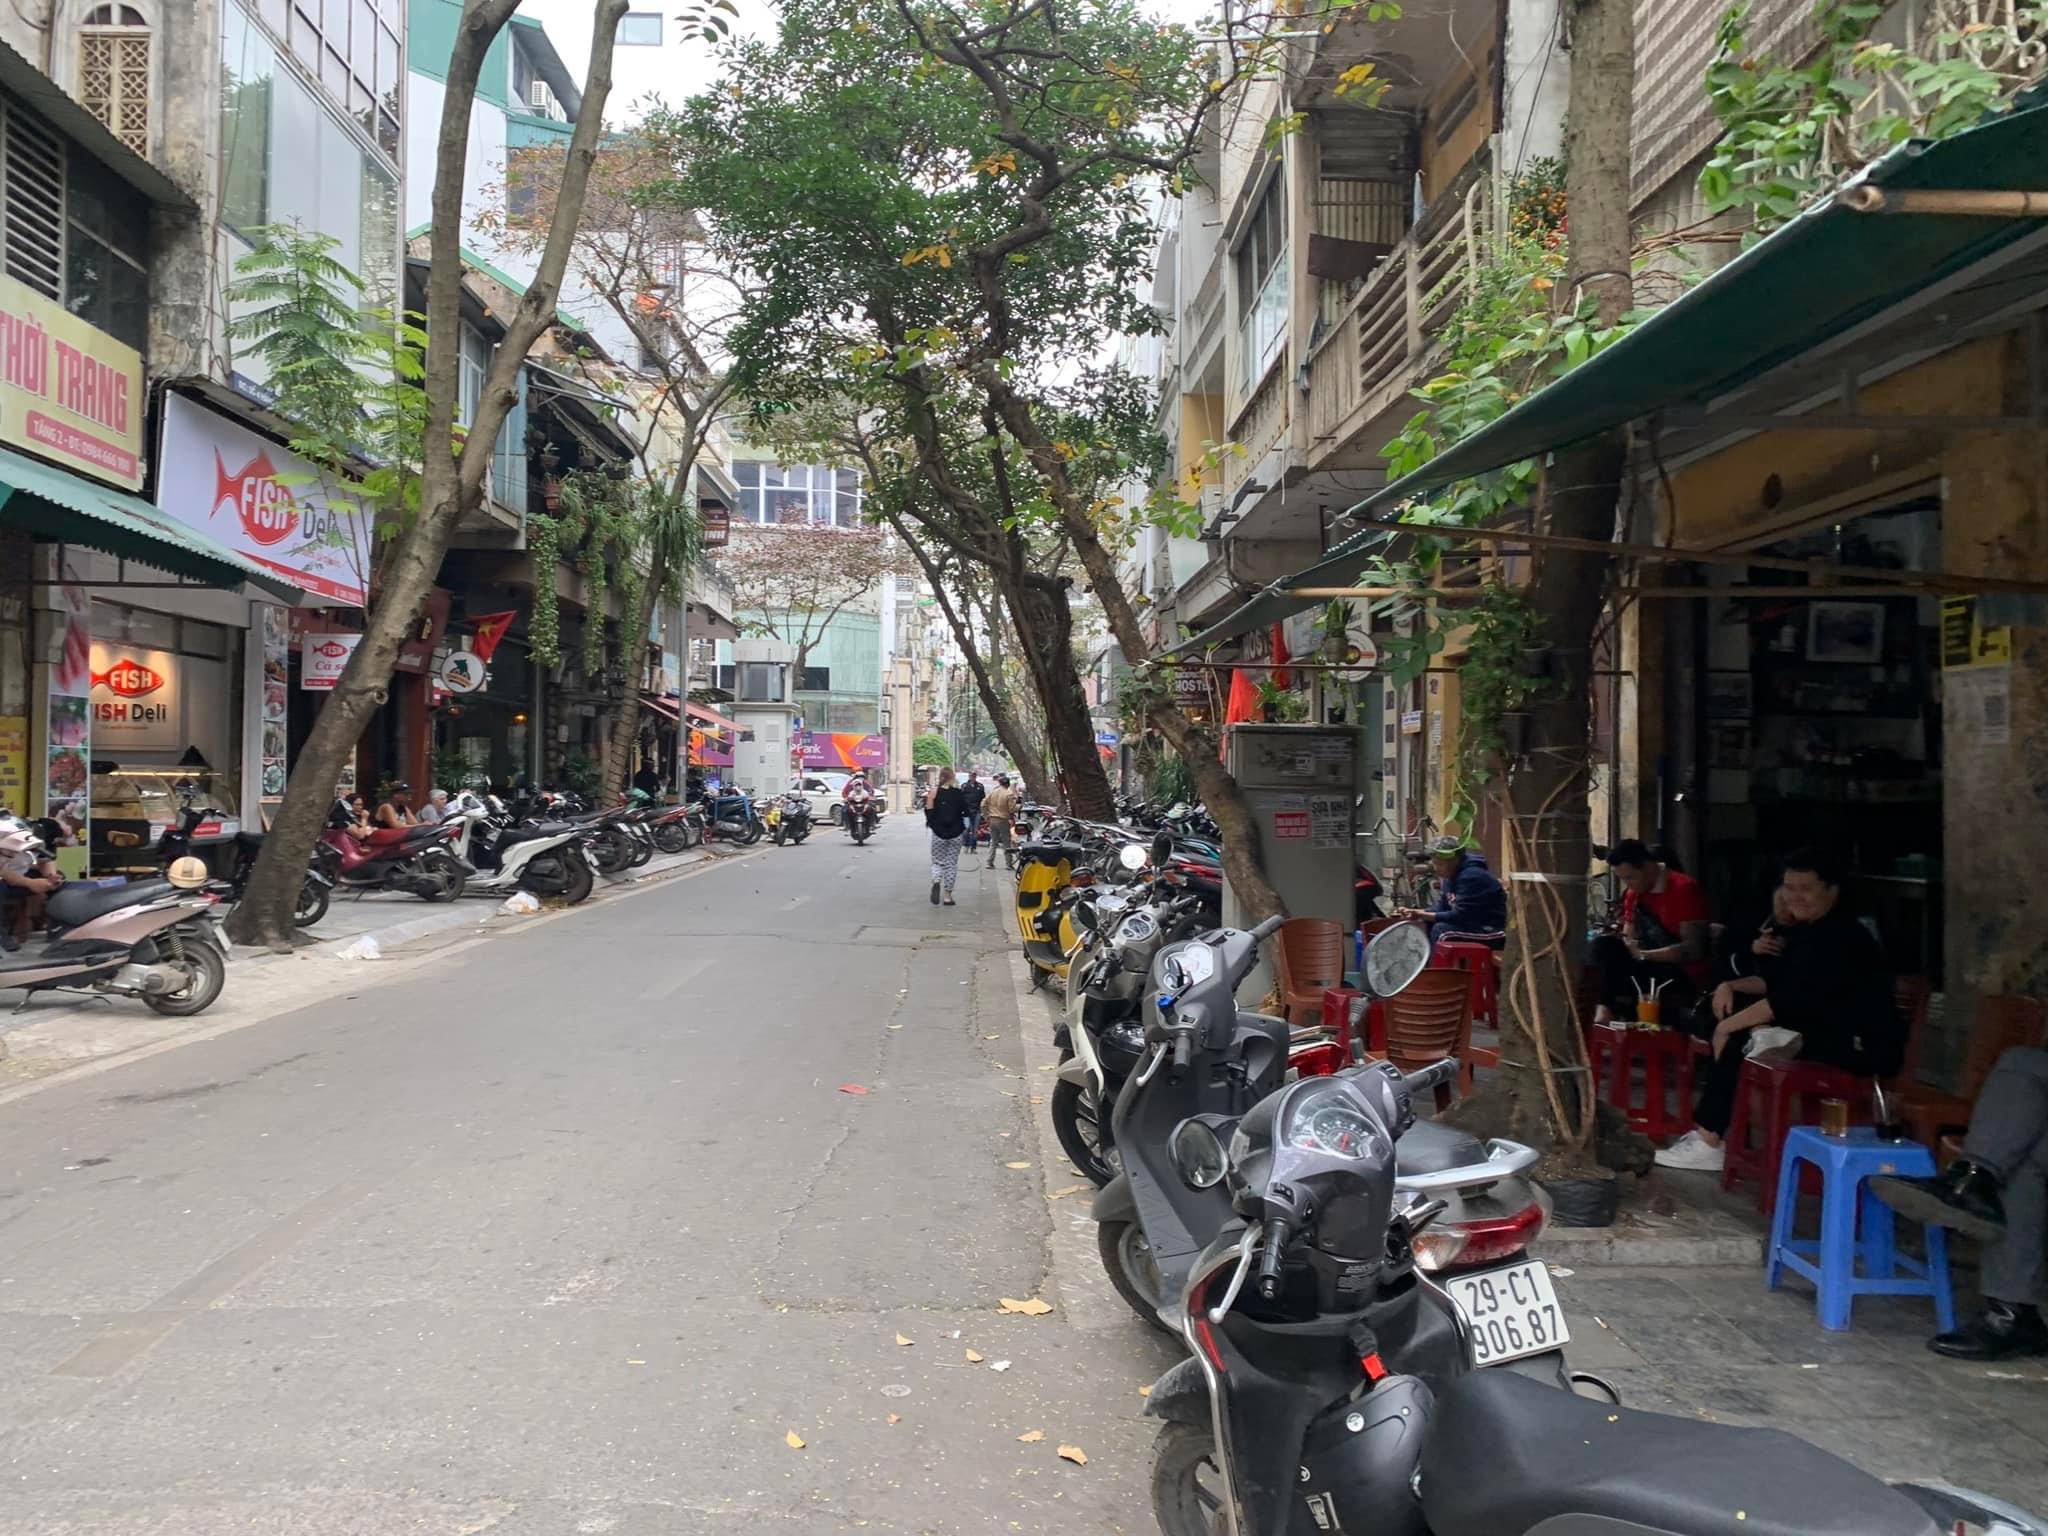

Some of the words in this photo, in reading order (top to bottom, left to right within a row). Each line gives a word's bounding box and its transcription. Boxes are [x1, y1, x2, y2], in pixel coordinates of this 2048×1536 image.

[55, 339, 128, 434] TRANG
[241, 476, 289, 530] FISH
[110, 668, 153, 689] FISH
[94, 703, 128, 720] ISH
[131, 702, 167, 720] Deli
[1465, 1267, 1541, 1317] 29-C1
[1471, 1304, 1558, 1359] 906.87
